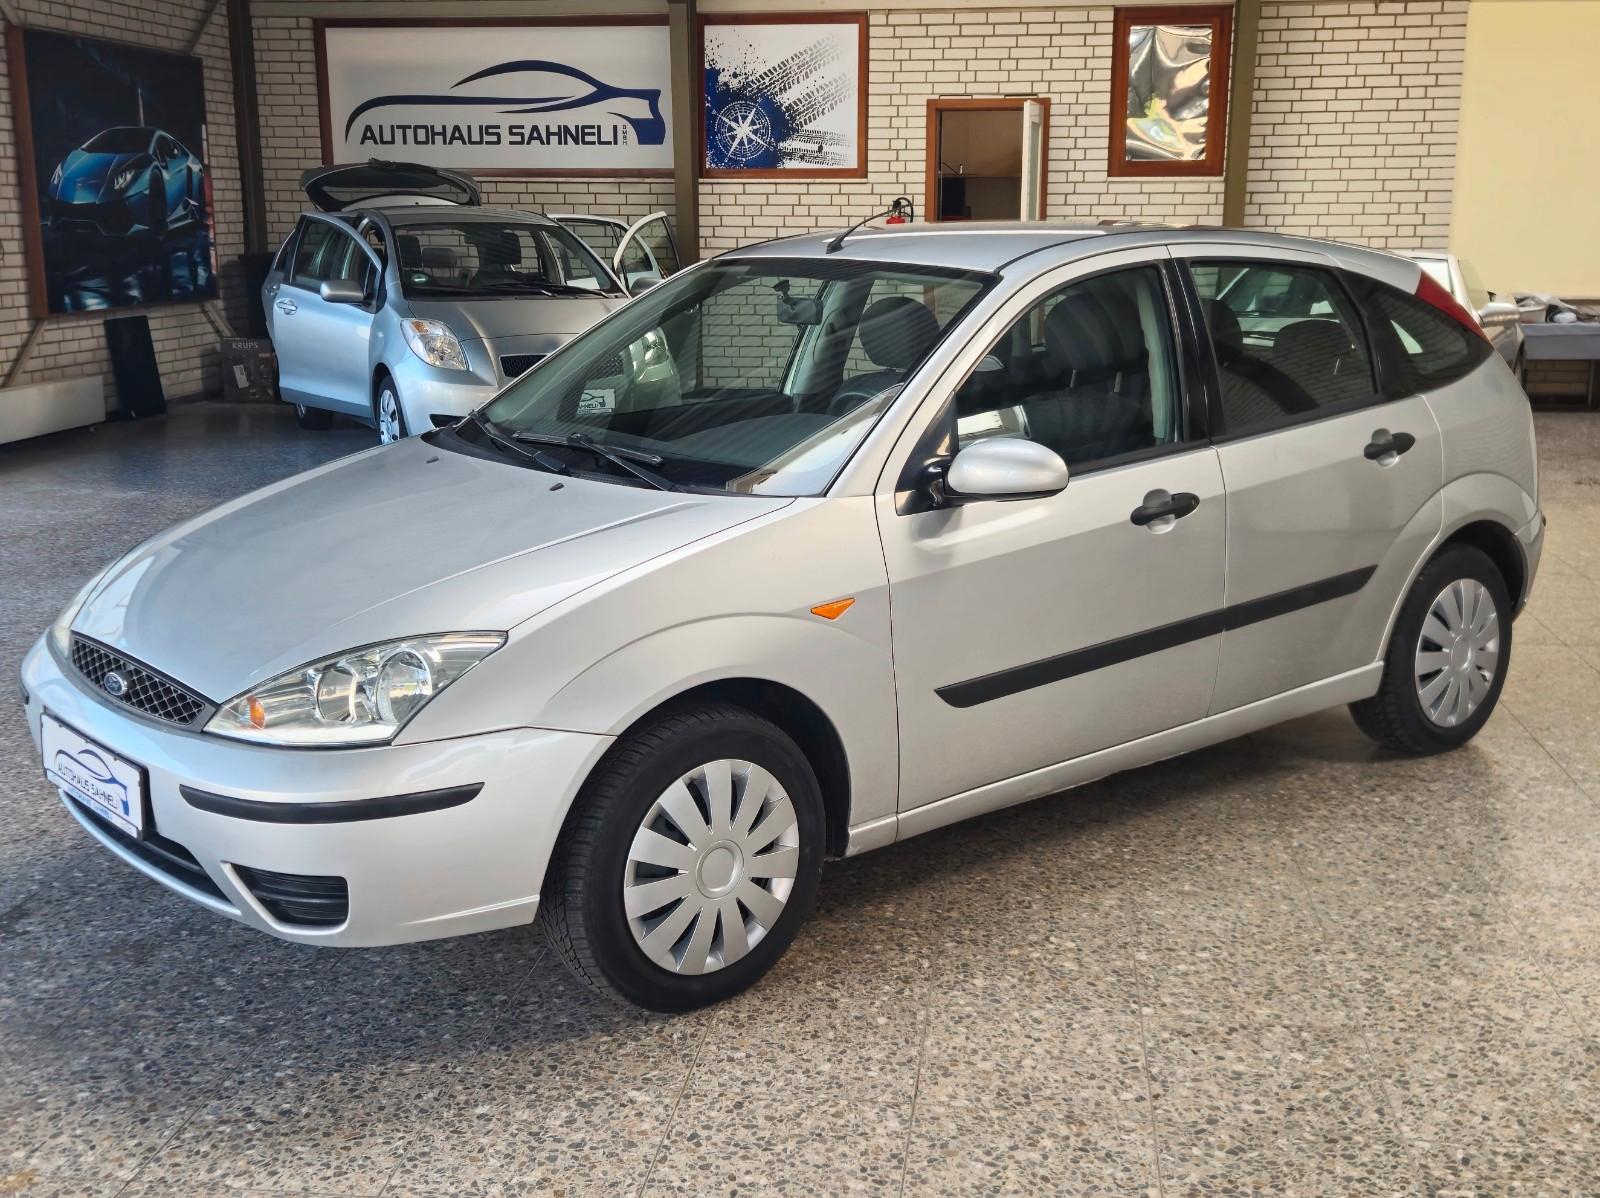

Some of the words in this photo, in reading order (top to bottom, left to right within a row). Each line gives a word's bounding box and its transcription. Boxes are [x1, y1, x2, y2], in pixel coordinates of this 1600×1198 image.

[360, 124, 501, 145] AUTOHAUS
[508, 124, 618, 145] SAHNELI
[232, 341, 259, 350] KRUPS
